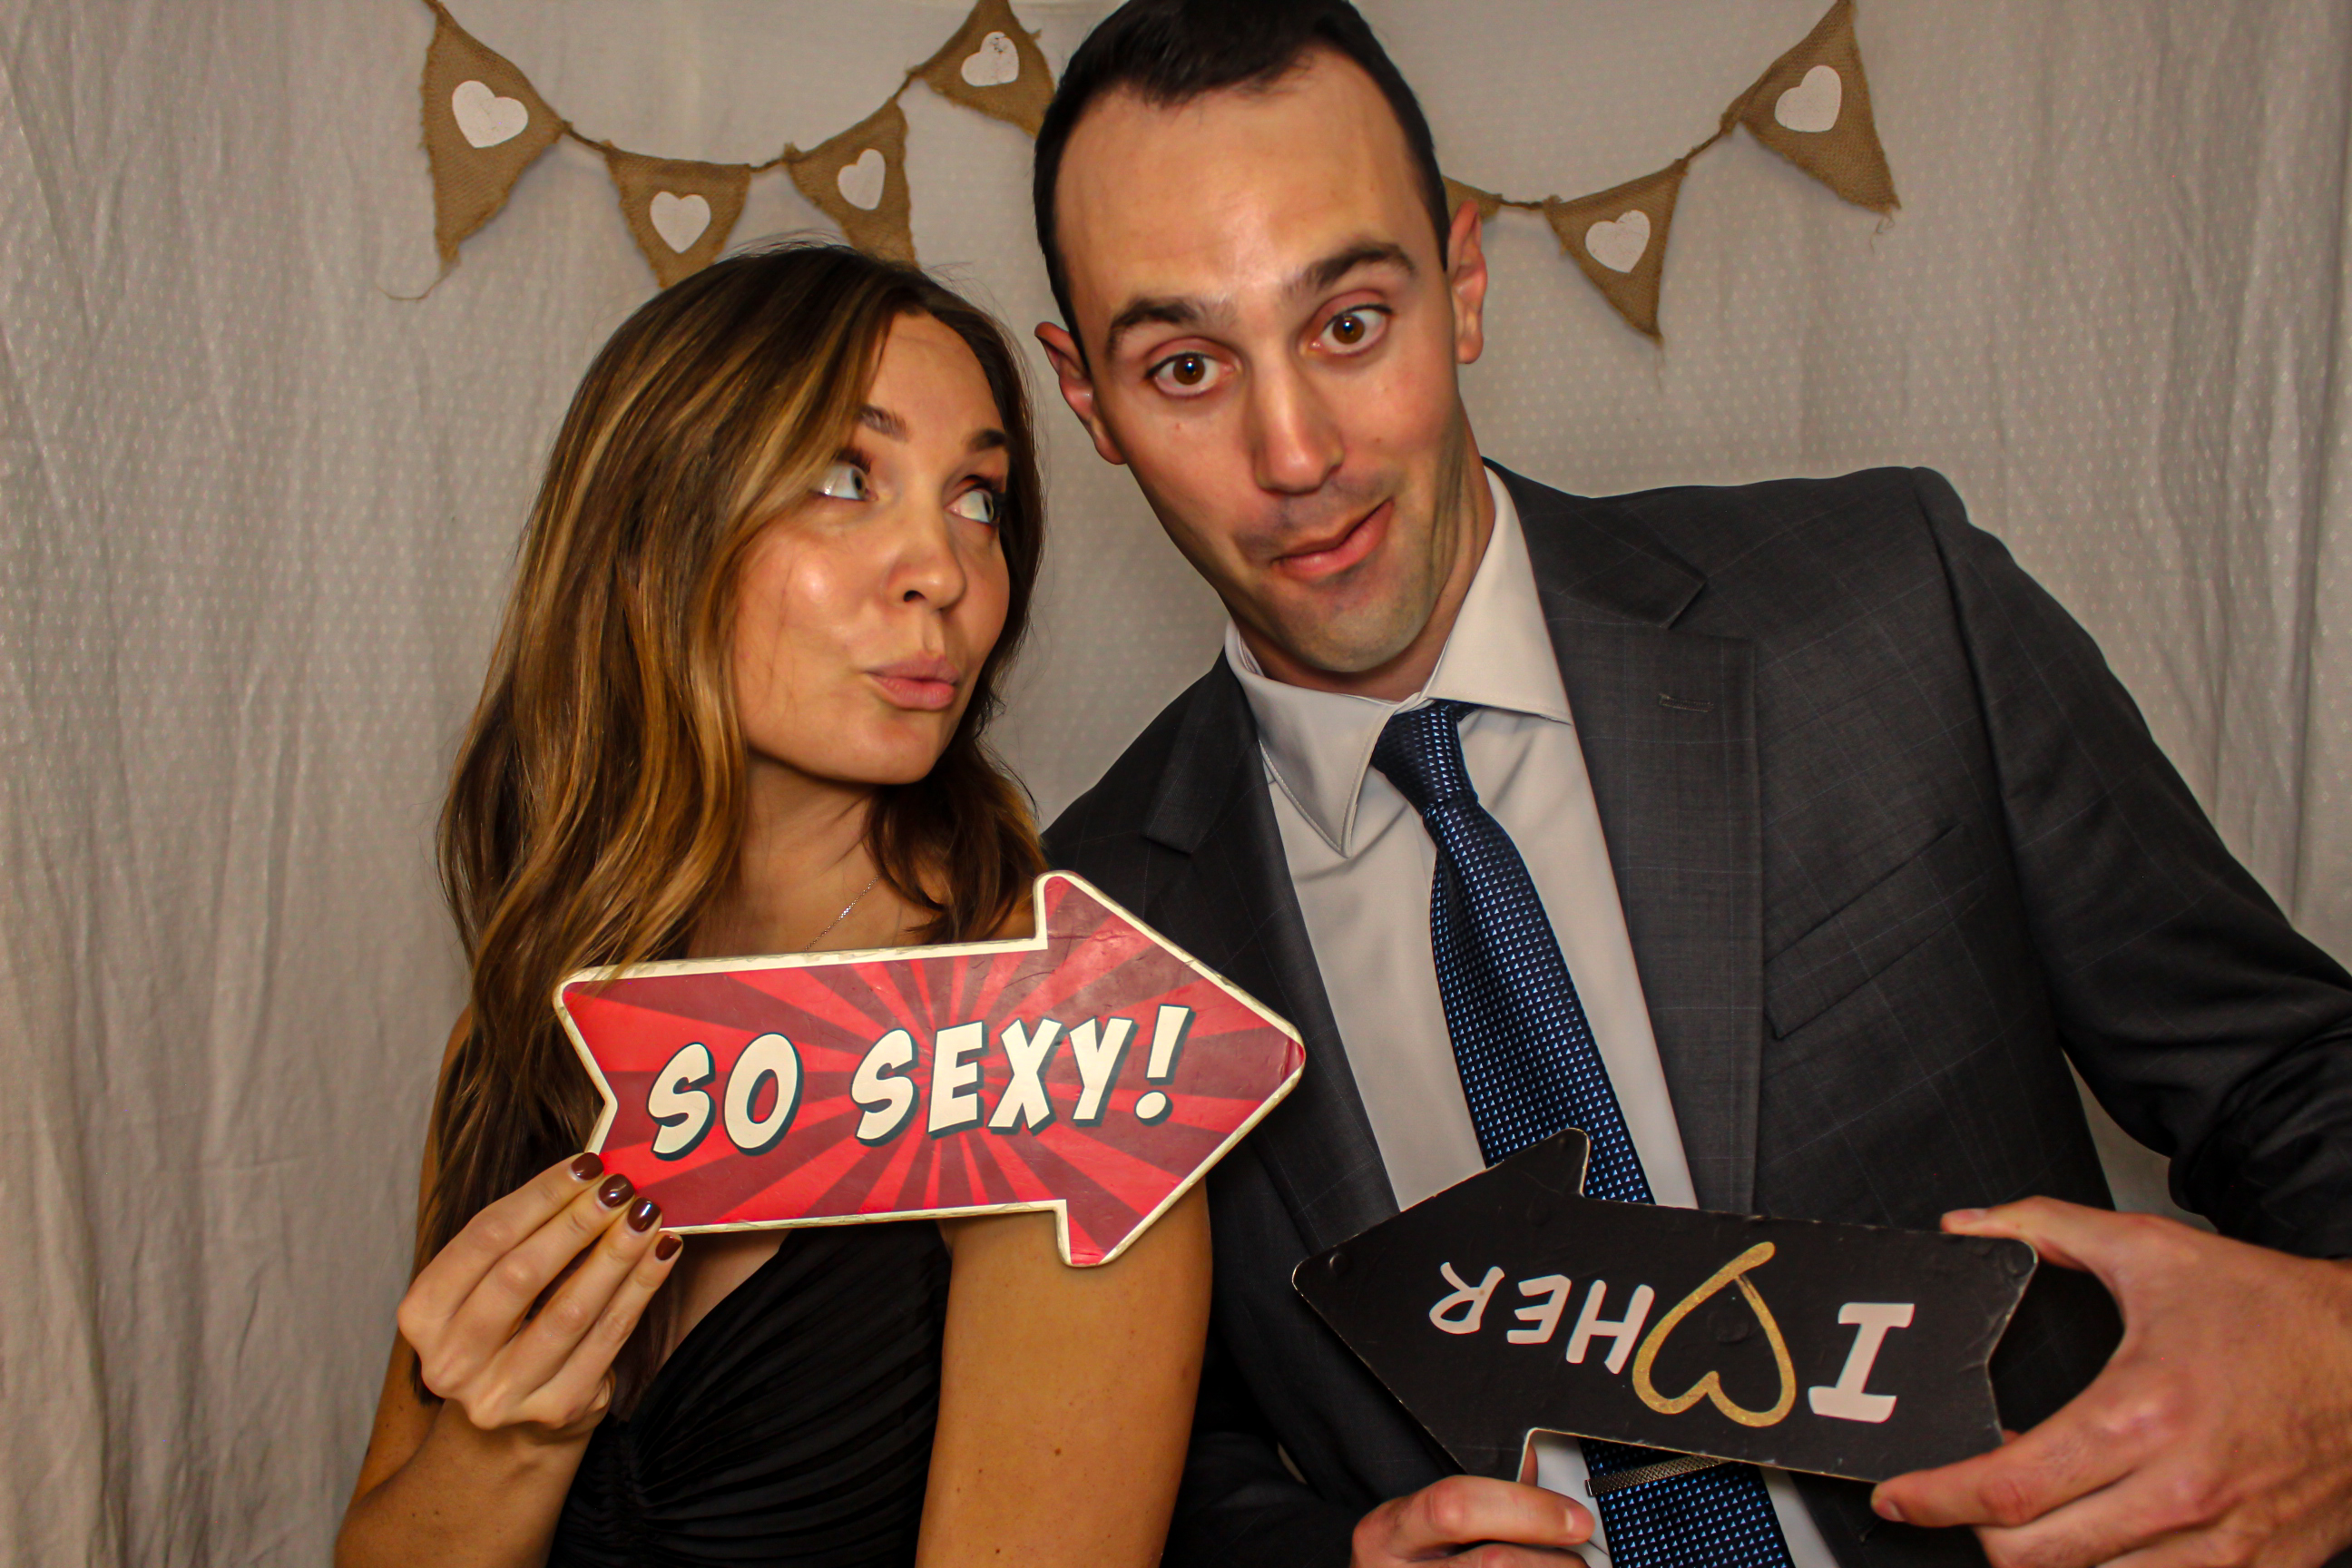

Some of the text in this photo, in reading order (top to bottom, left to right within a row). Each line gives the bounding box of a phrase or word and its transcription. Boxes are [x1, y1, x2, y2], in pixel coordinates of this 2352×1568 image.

[647, 1004, 1195, 1160] SO SEXY!
[1428, 1261, 1915, 1423] I HER
